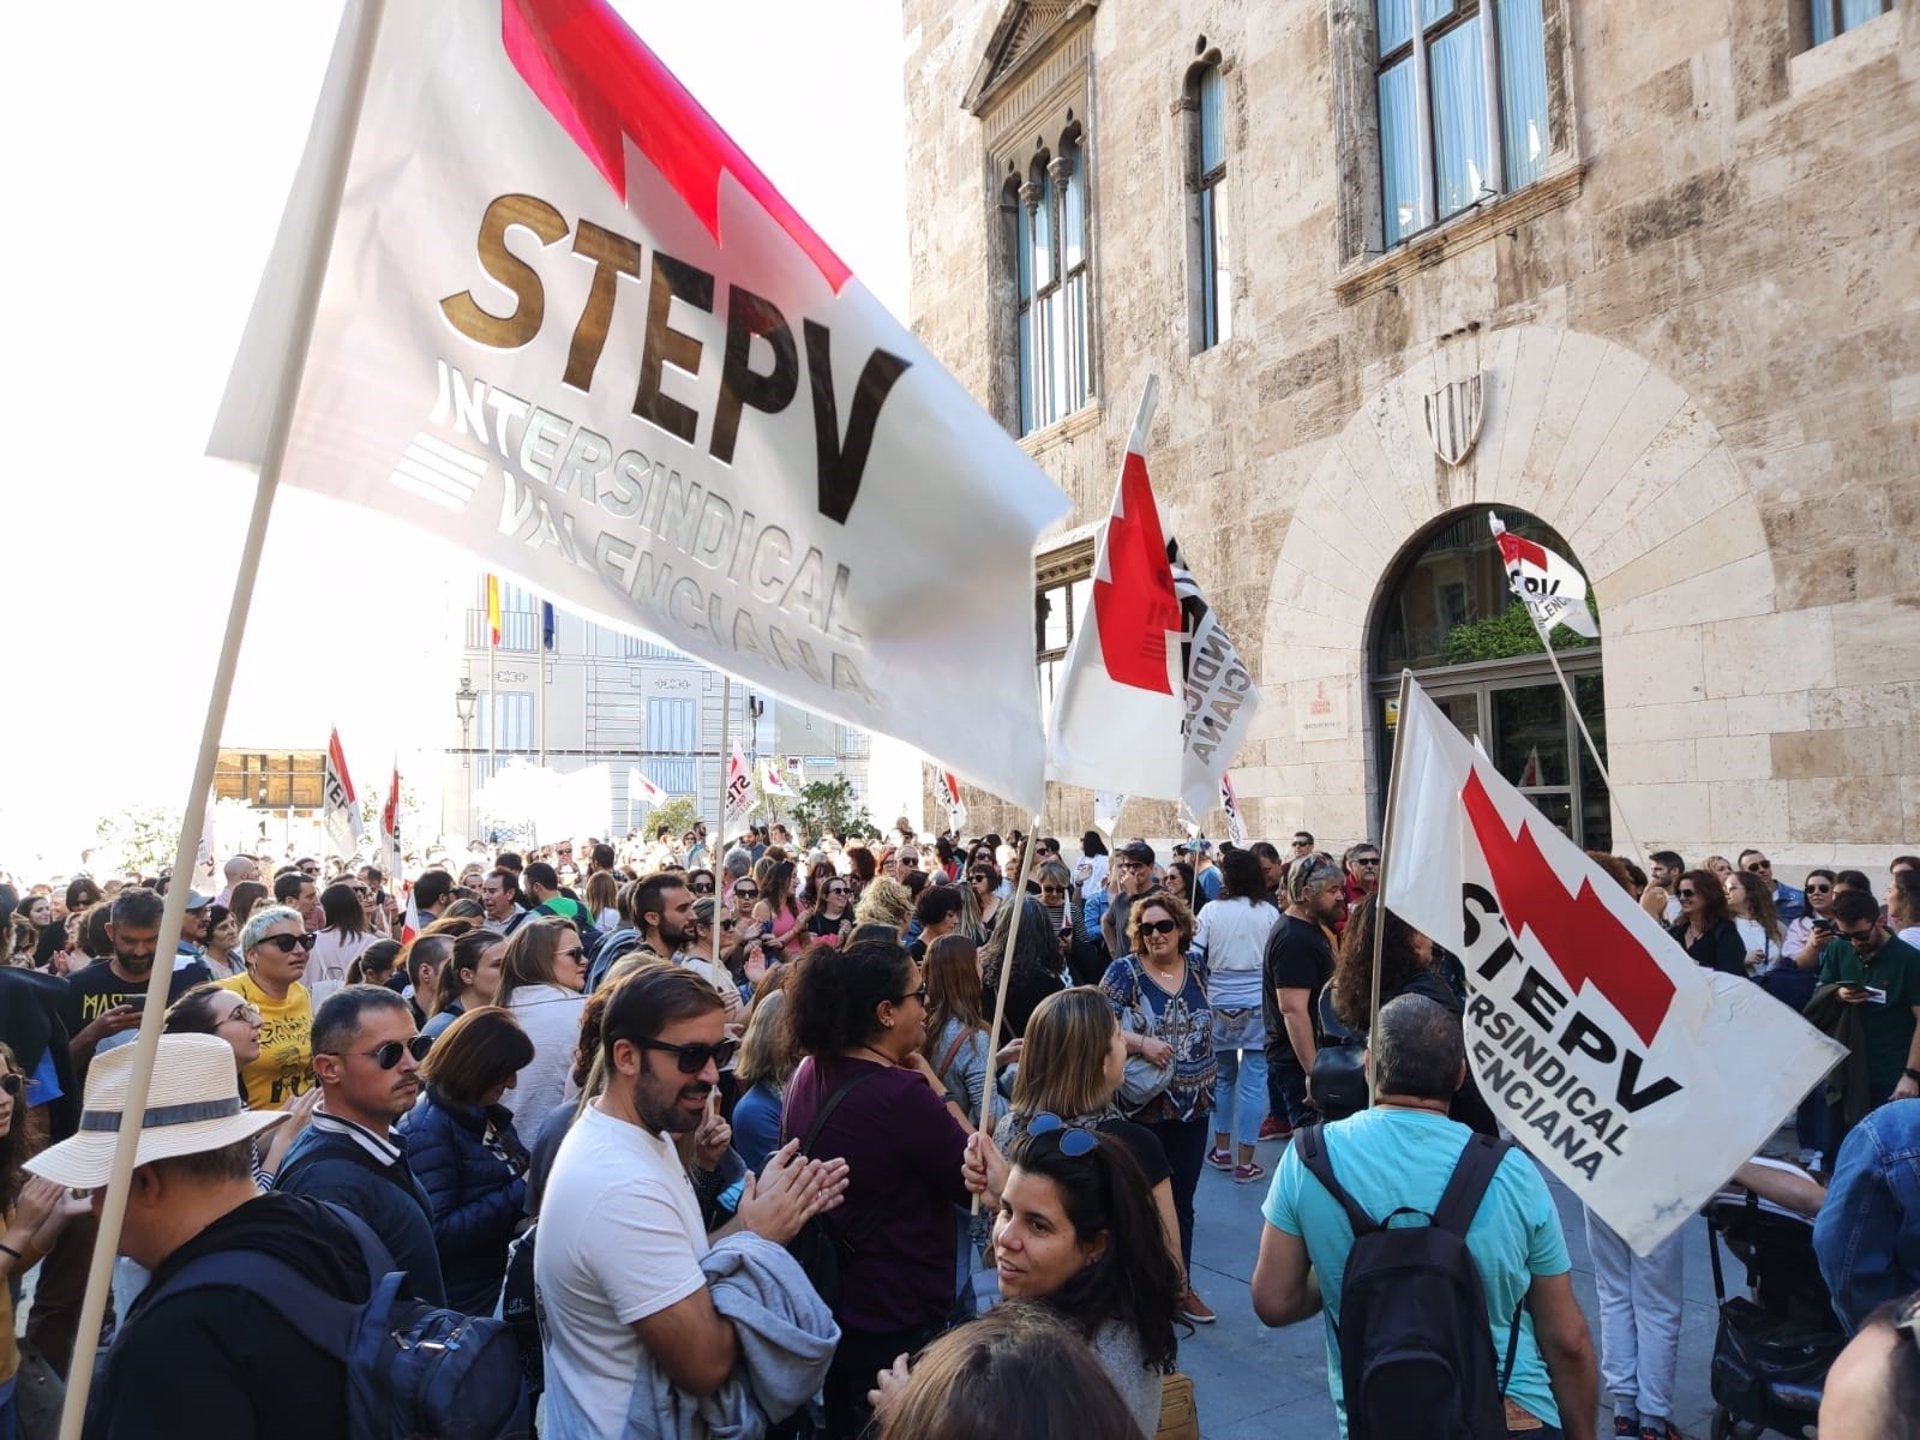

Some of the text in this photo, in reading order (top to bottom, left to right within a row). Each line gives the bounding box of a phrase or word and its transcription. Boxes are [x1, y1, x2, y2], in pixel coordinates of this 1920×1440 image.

[439, 193, 913, 525] STEPV
[428, 359, 864, 641] INTERSINDICAL
[498, 470, 876, 703] VALENCIANA
[1462, 883, 1684, 1114] STEPV
[1467, 987, 1630, 1156] RSINDICAL
[1473, 1040, 1604, 1181] ENCIANA
